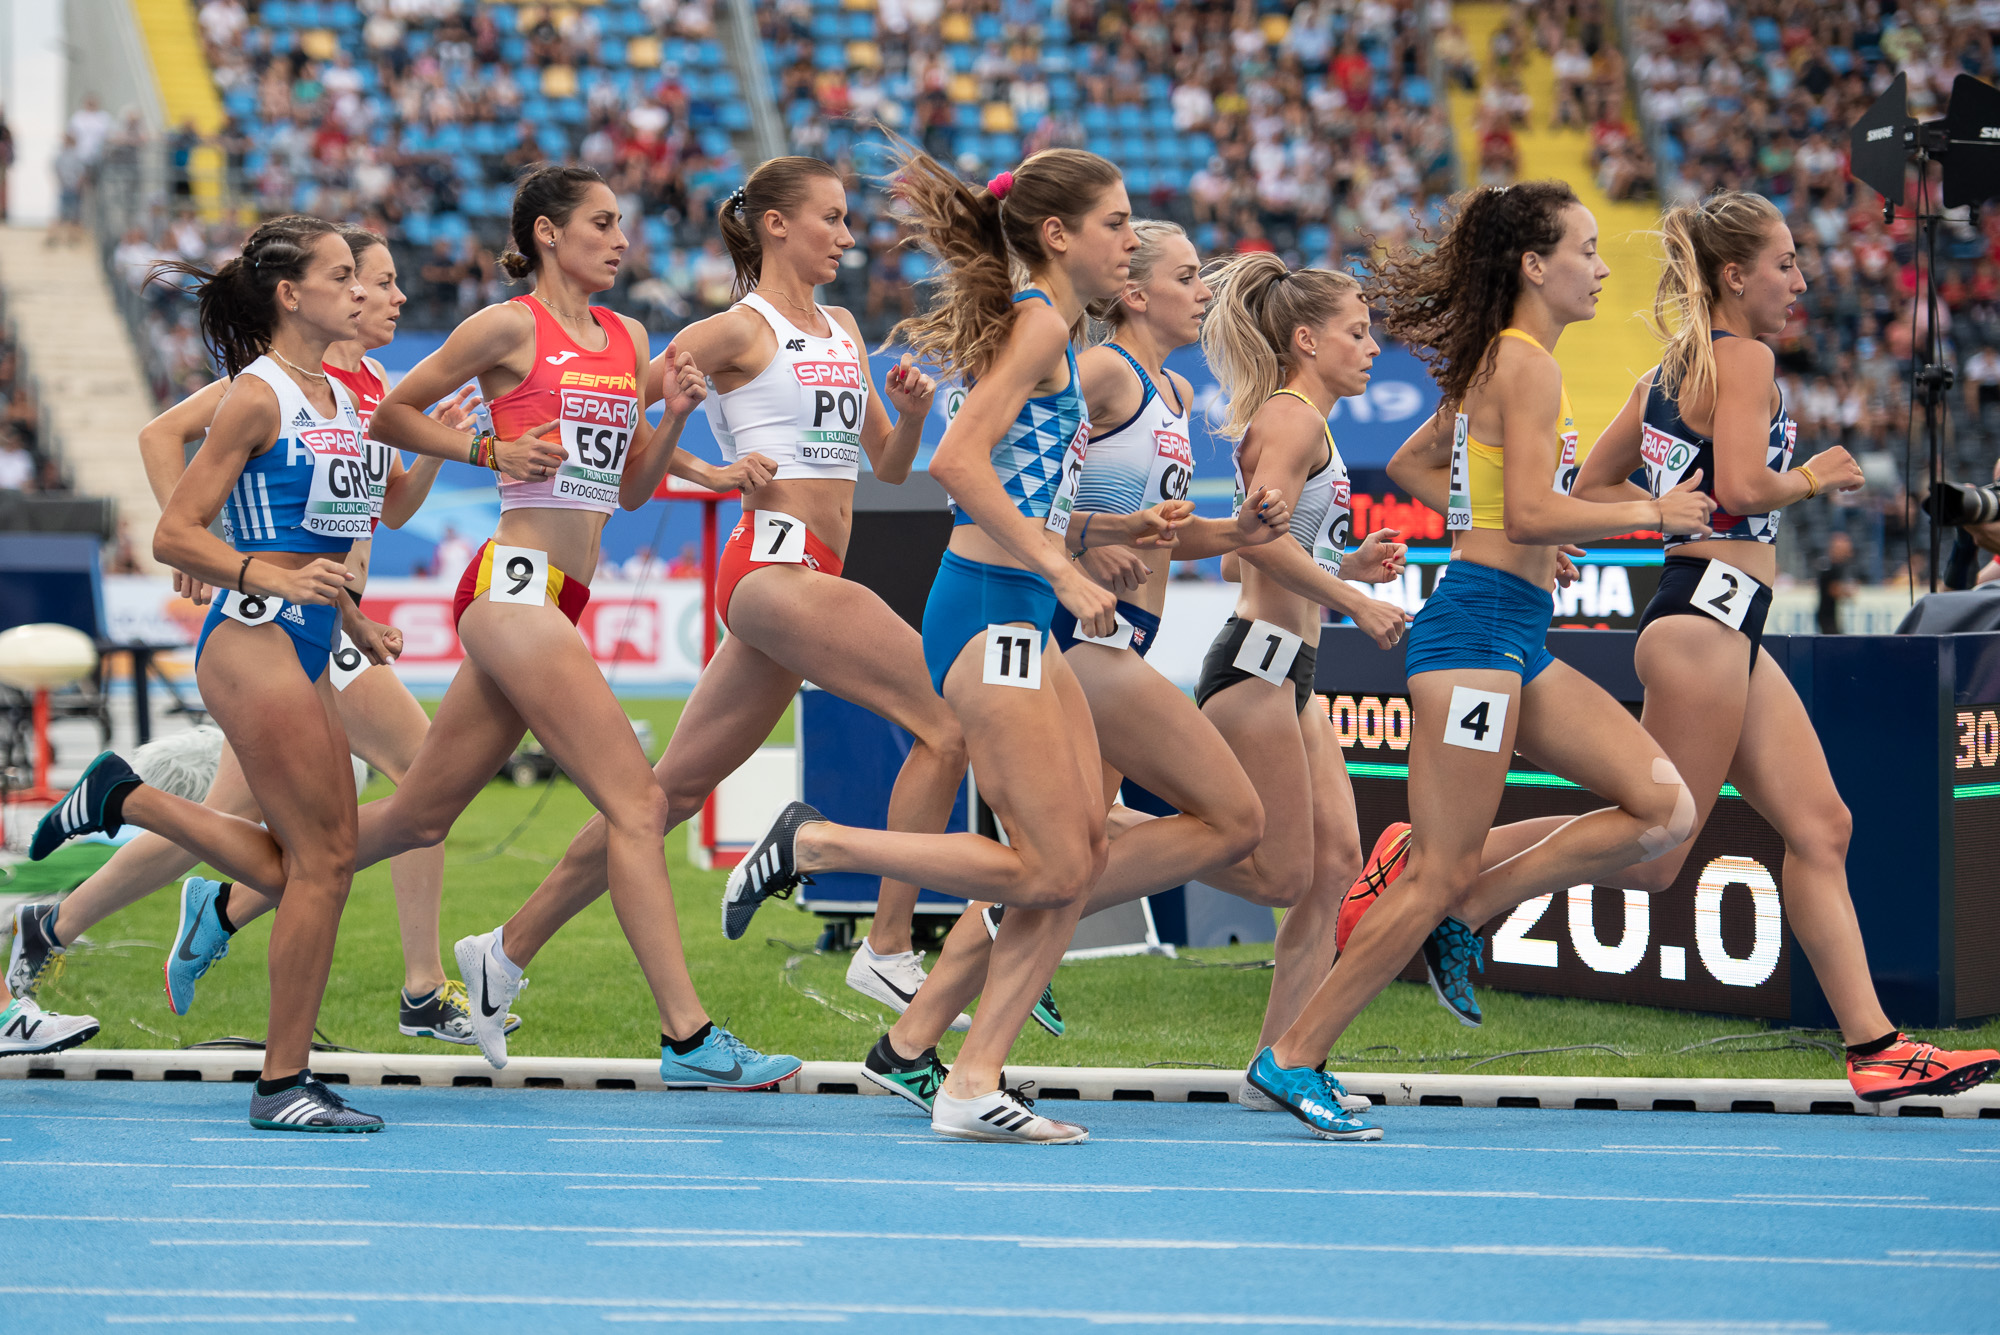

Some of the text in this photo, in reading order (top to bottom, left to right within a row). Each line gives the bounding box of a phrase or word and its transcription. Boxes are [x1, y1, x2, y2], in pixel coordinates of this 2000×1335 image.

[797, 364, 859, 386] SPAR
[291, 420, 317, 428] adidas
[564, 396, 628, 425] SPAR
[305, 432, 361, 454] SPAR
[576, 426, 628, 470] ESP
[826, 431, 845, 442] RUN
[1159, 434, 1192, 463] SPAR
[336, 502, 355, 513] RUN
[768, 517, 794, 555] 7
[506, 556, 534, 596] 9
[1707, 572, 1739, 615] 2
[281, 611, 306, 626] adidas
[996, 635, 1031, 679] 11
[1259, 633, 1283, 672] 1
[1460, 701, 1490, 741] 4
